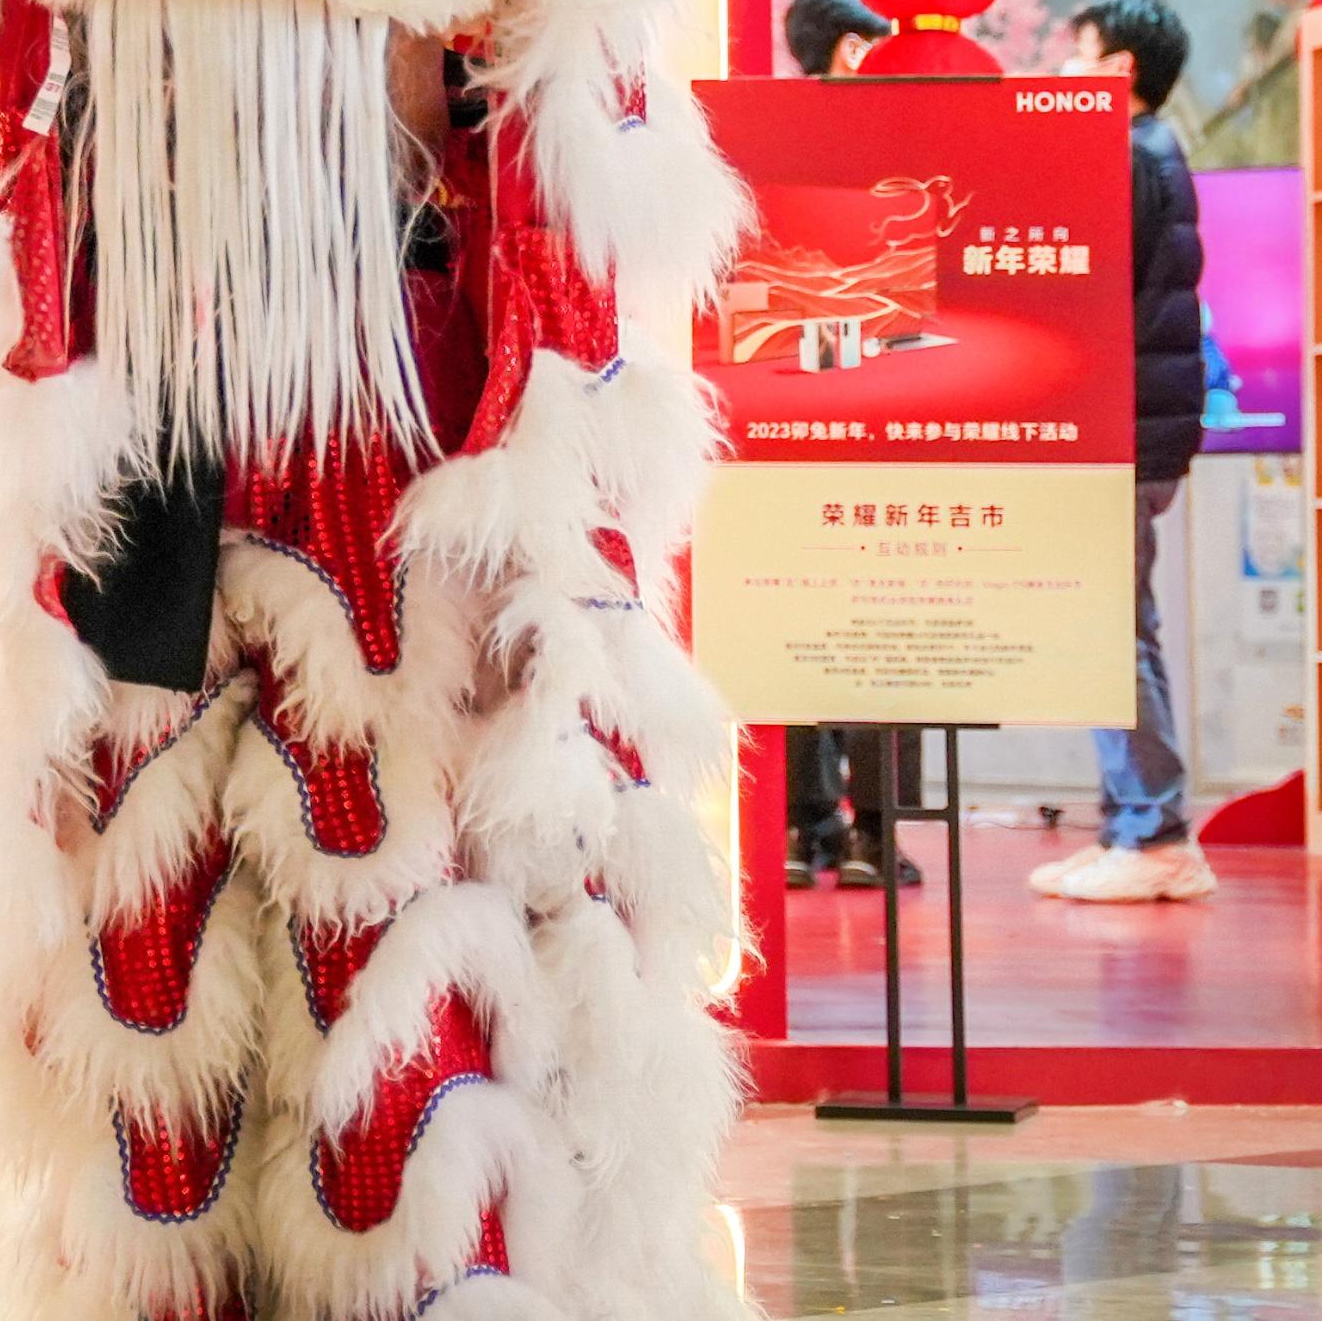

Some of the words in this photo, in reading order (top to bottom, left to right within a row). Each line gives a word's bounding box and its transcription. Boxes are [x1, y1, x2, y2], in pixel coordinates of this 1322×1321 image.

[1016, 91, 1113, 112] HONOR
[963, 244, 1091, 275] 新年荣耀
[821, 503, 1005, 528] 荣耀新年吉市
